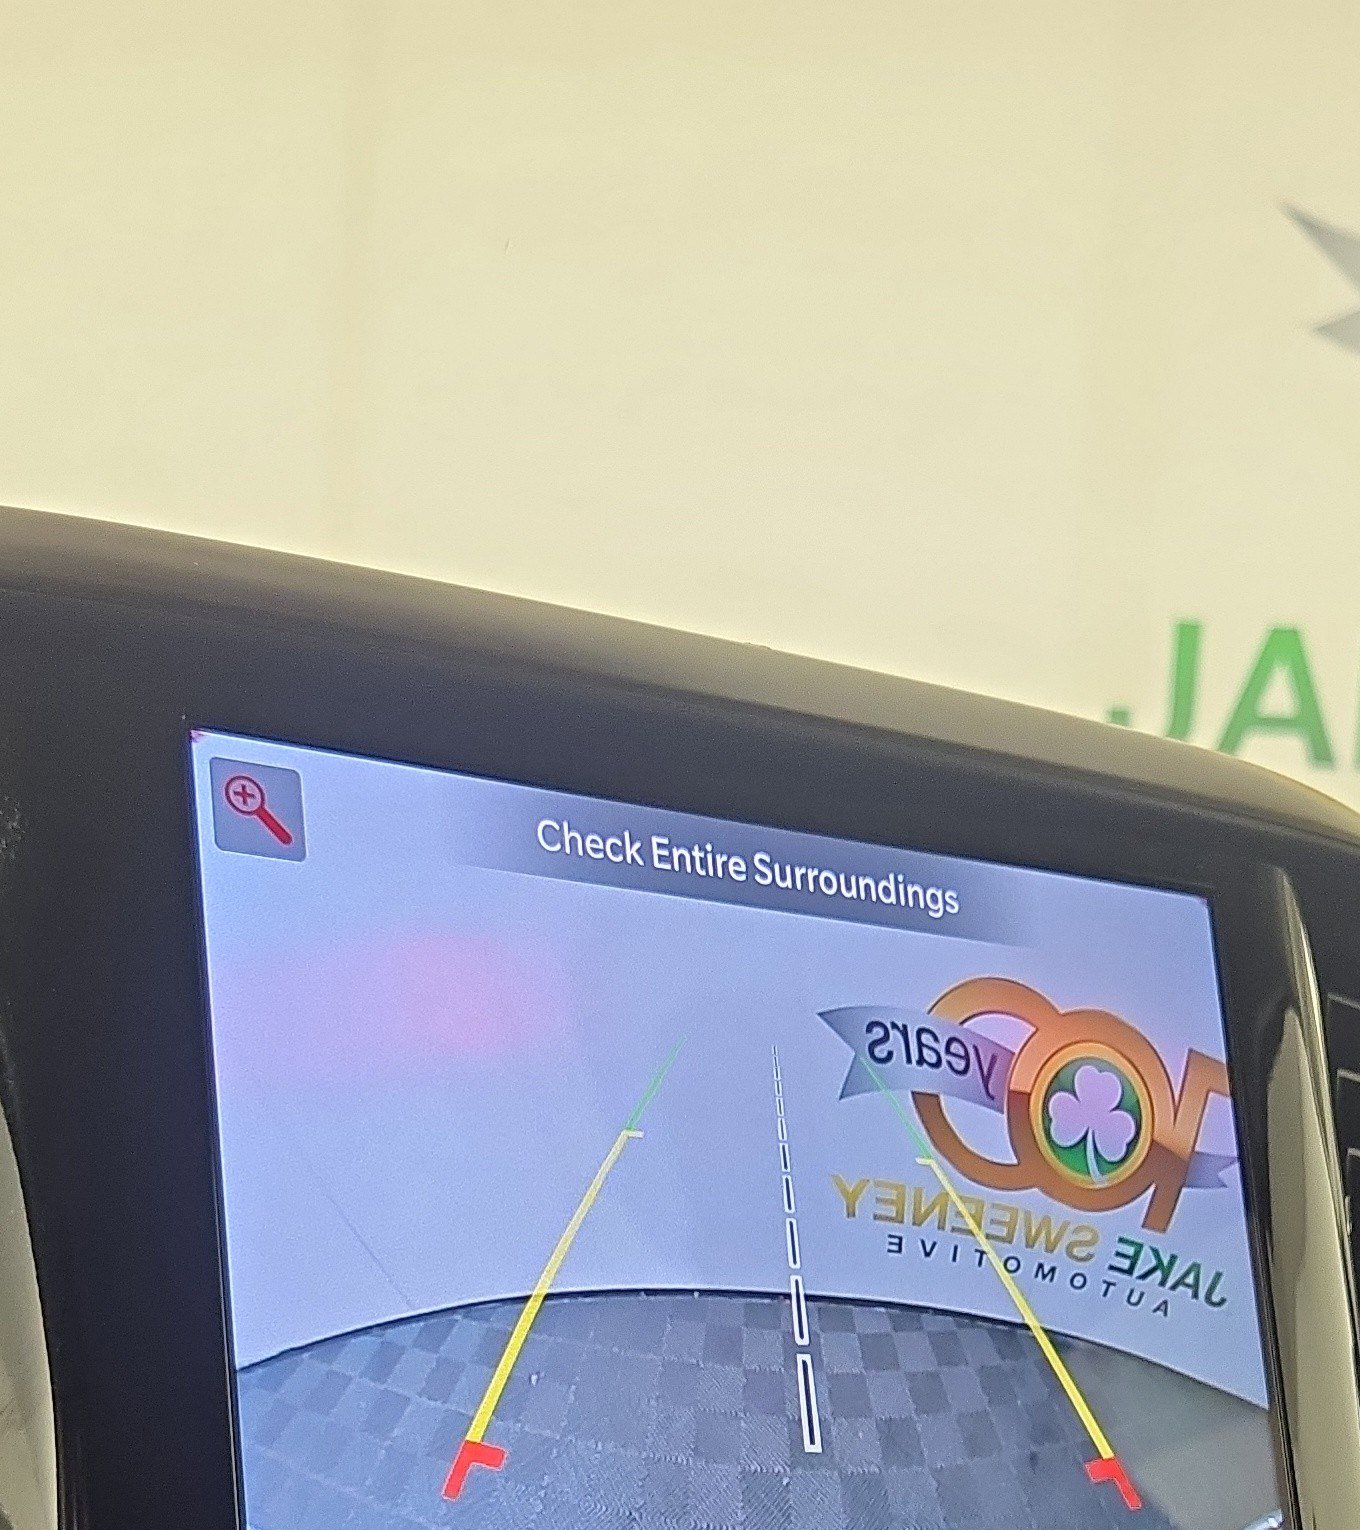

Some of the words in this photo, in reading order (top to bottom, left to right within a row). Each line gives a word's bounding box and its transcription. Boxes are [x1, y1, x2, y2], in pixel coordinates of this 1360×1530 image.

[536, 818, 645, 867] Check
[651, 835, 748, 882] Entire
[753, 851, 960, 919] Surroundings
